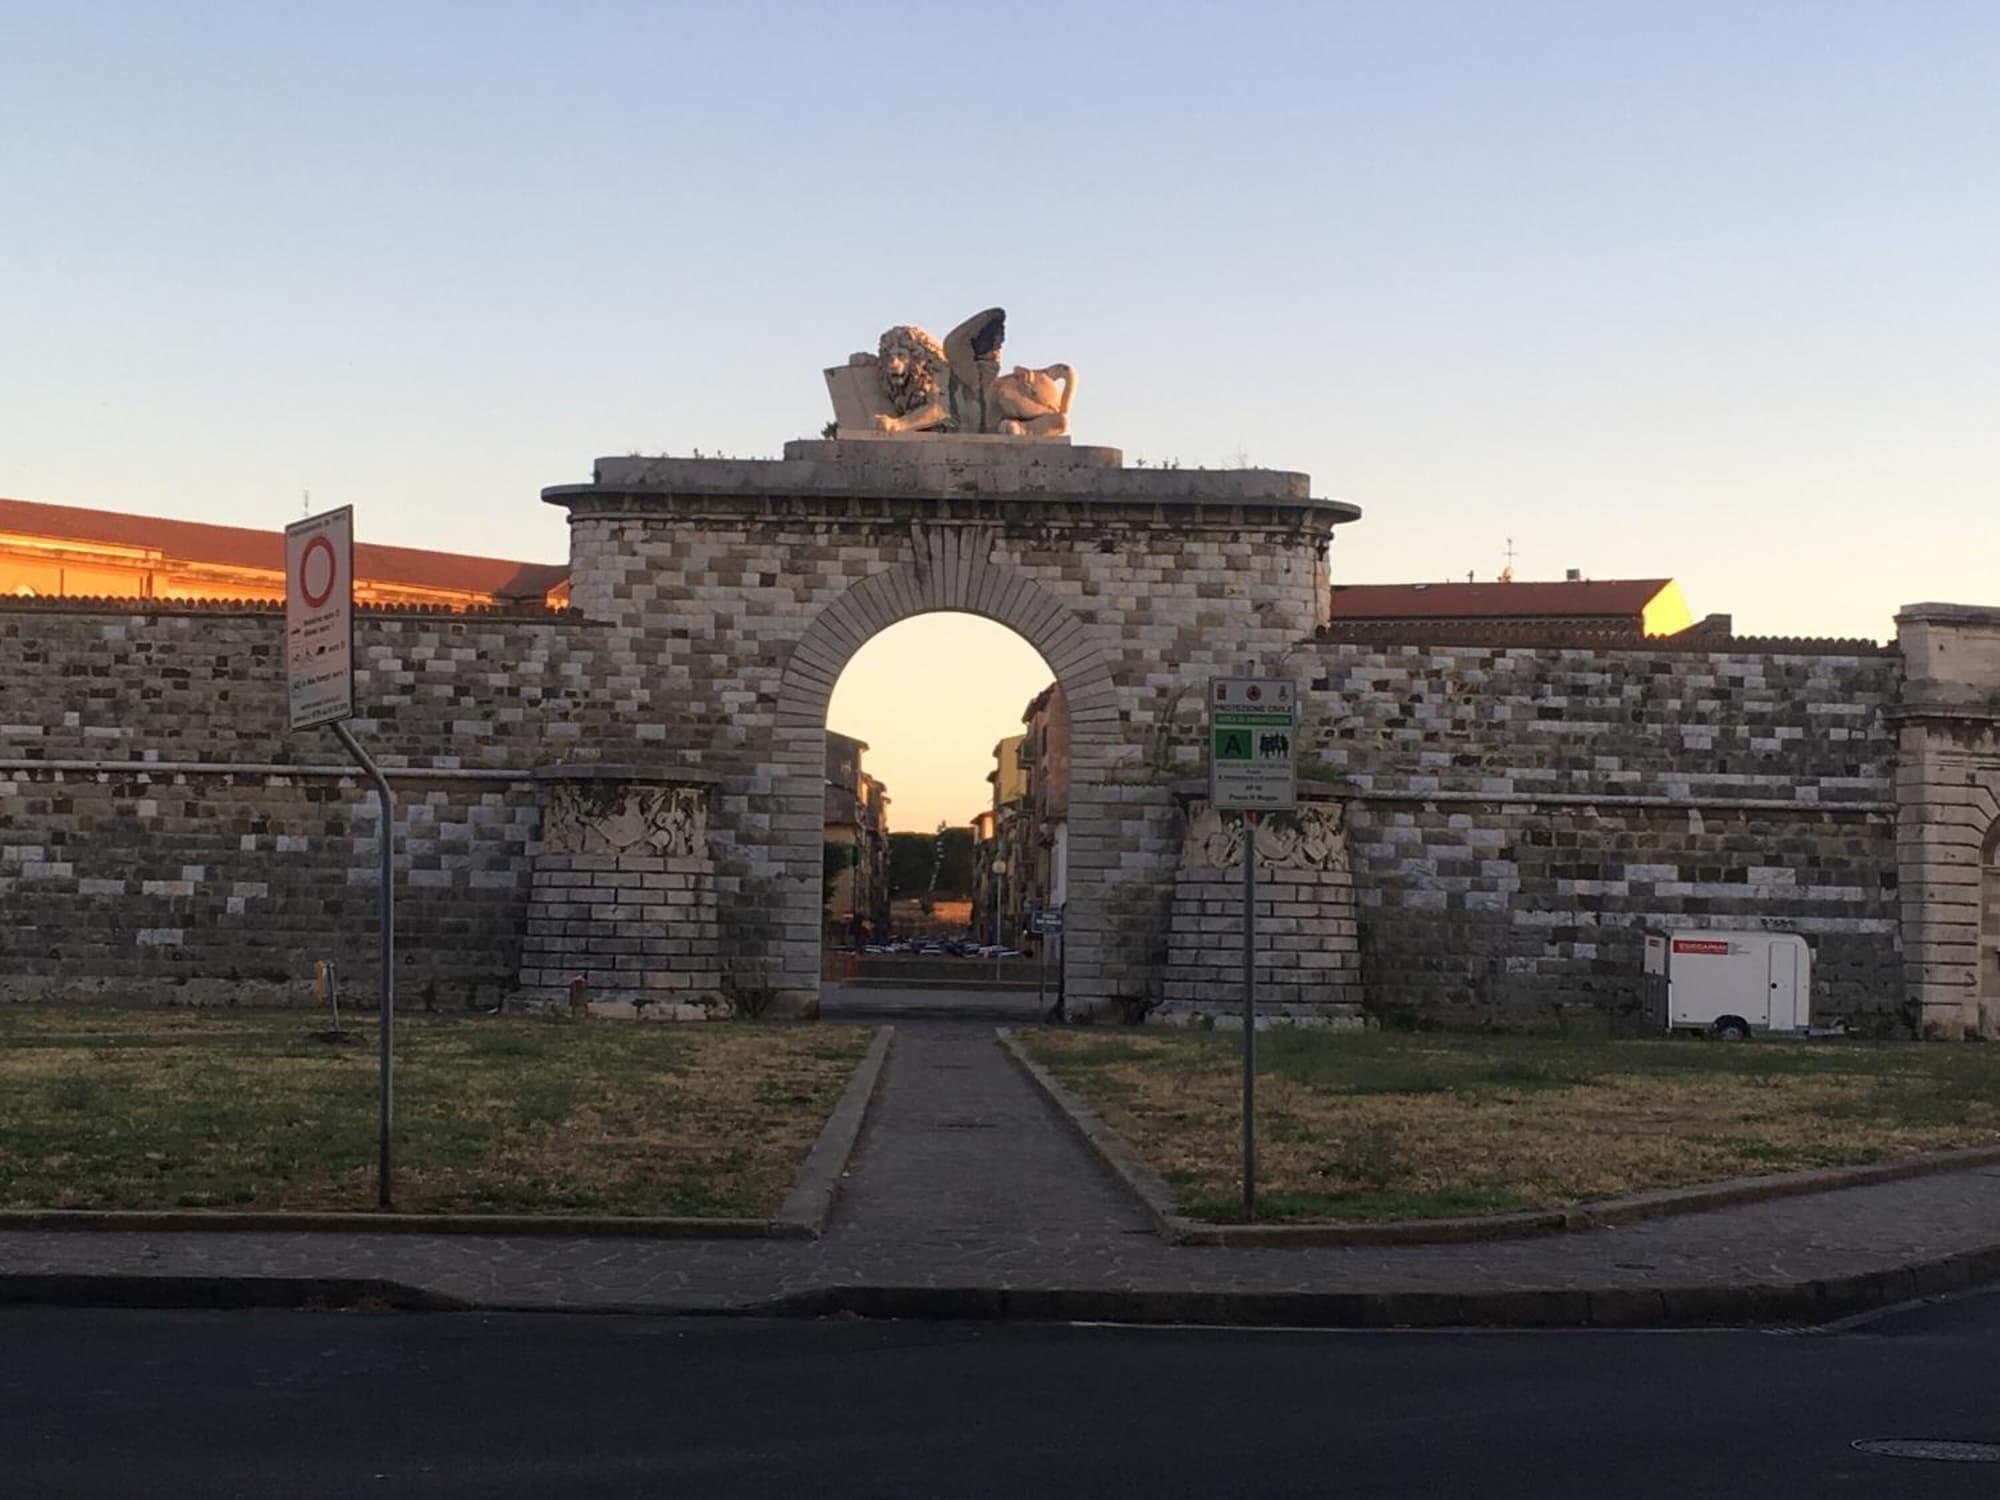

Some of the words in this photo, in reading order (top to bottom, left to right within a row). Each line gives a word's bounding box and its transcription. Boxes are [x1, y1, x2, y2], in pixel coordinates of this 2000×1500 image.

[1215, 704, 1265, 712] PROTEZIONE
[1268, 704, 1292, 713] CIVILE
[1224, 734, 1242, 755] A
